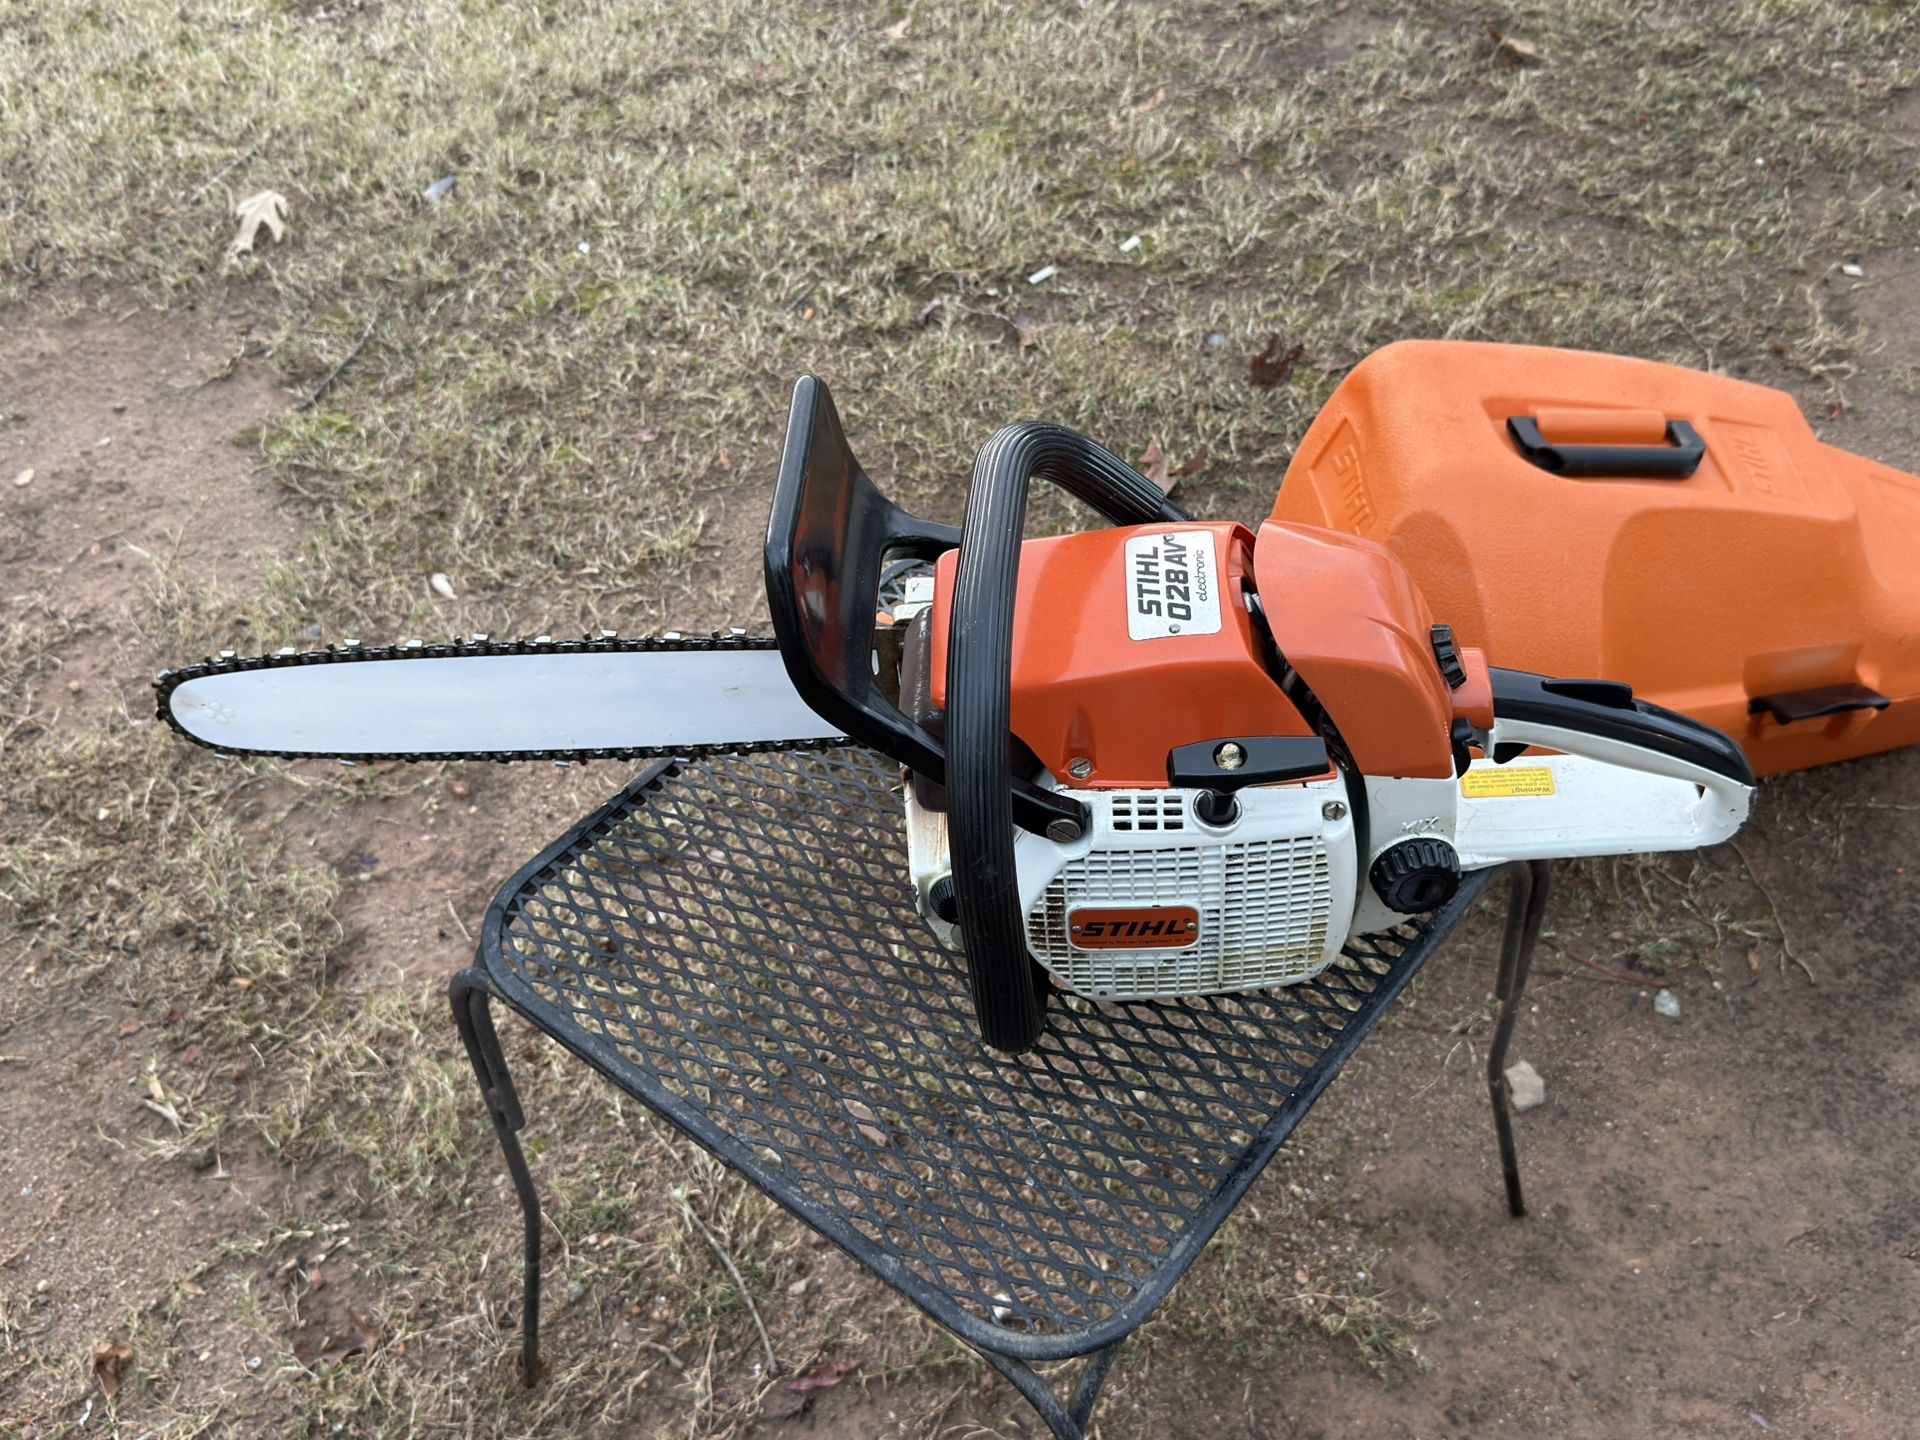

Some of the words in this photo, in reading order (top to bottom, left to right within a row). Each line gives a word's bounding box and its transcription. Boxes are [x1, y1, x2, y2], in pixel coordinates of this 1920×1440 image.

[1136, 546, 1162, 617] STIHL
[1193, 549, 1208, 602] electronic
[1511, 786, 1551, 794] Warning!
[1081, 919, 1187, 937] STIHL
